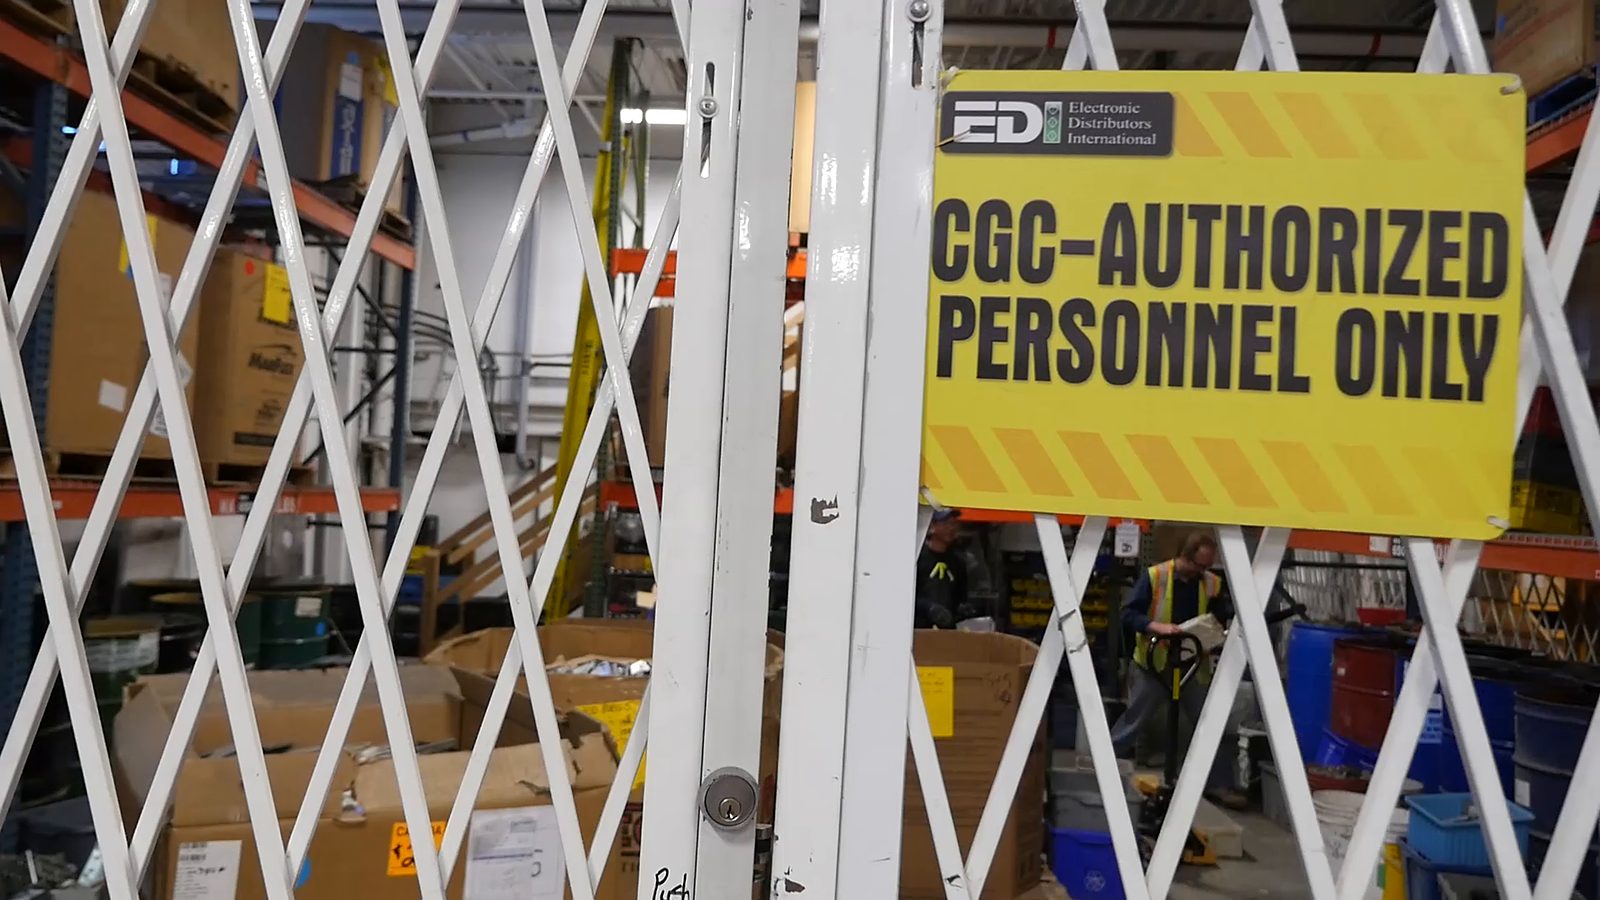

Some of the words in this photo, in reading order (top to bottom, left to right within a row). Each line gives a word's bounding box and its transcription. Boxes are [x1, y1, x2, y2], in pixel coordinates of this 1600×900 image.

[1068, 101, 1141, 114] Electronic
[1067, 117, 1152, 130] Distributors
[1067, 133, 1157, 146] International
[936, 295, 1311, 393] PERSONNEL
[1335, 307, 1499, 402] ONLY
